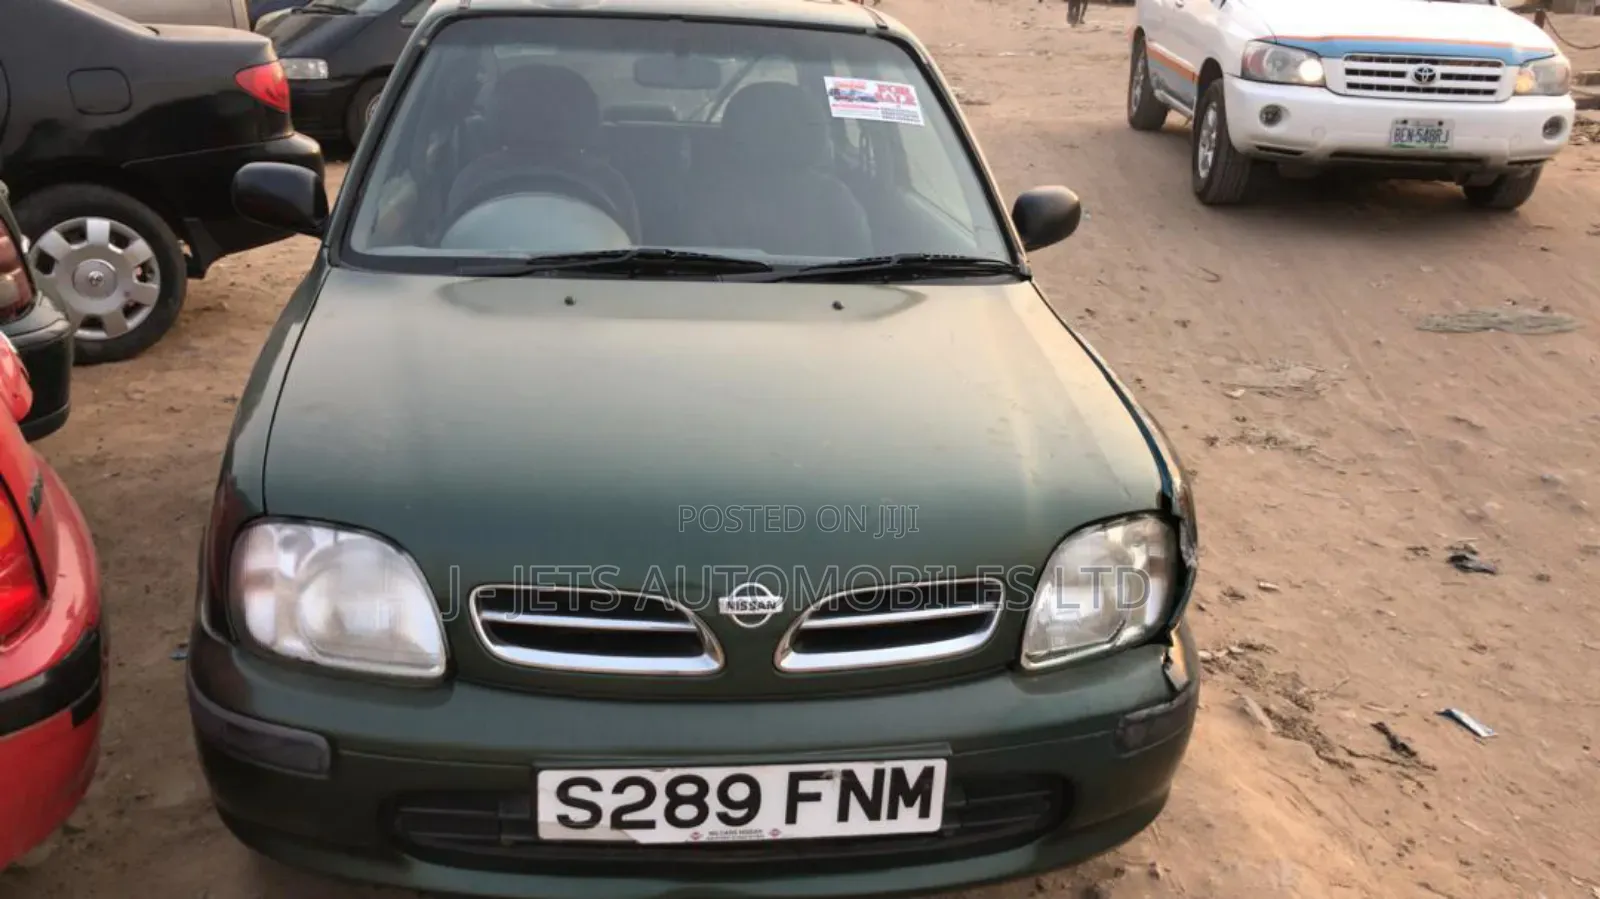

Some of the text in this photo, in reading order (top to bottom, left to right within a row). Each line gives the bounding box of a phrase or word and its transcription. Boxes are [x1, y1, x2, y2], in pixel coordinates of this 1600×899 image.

[726, 600, 776, 611] NISSAN
[555, 766, 936, 831] S289 FNM
